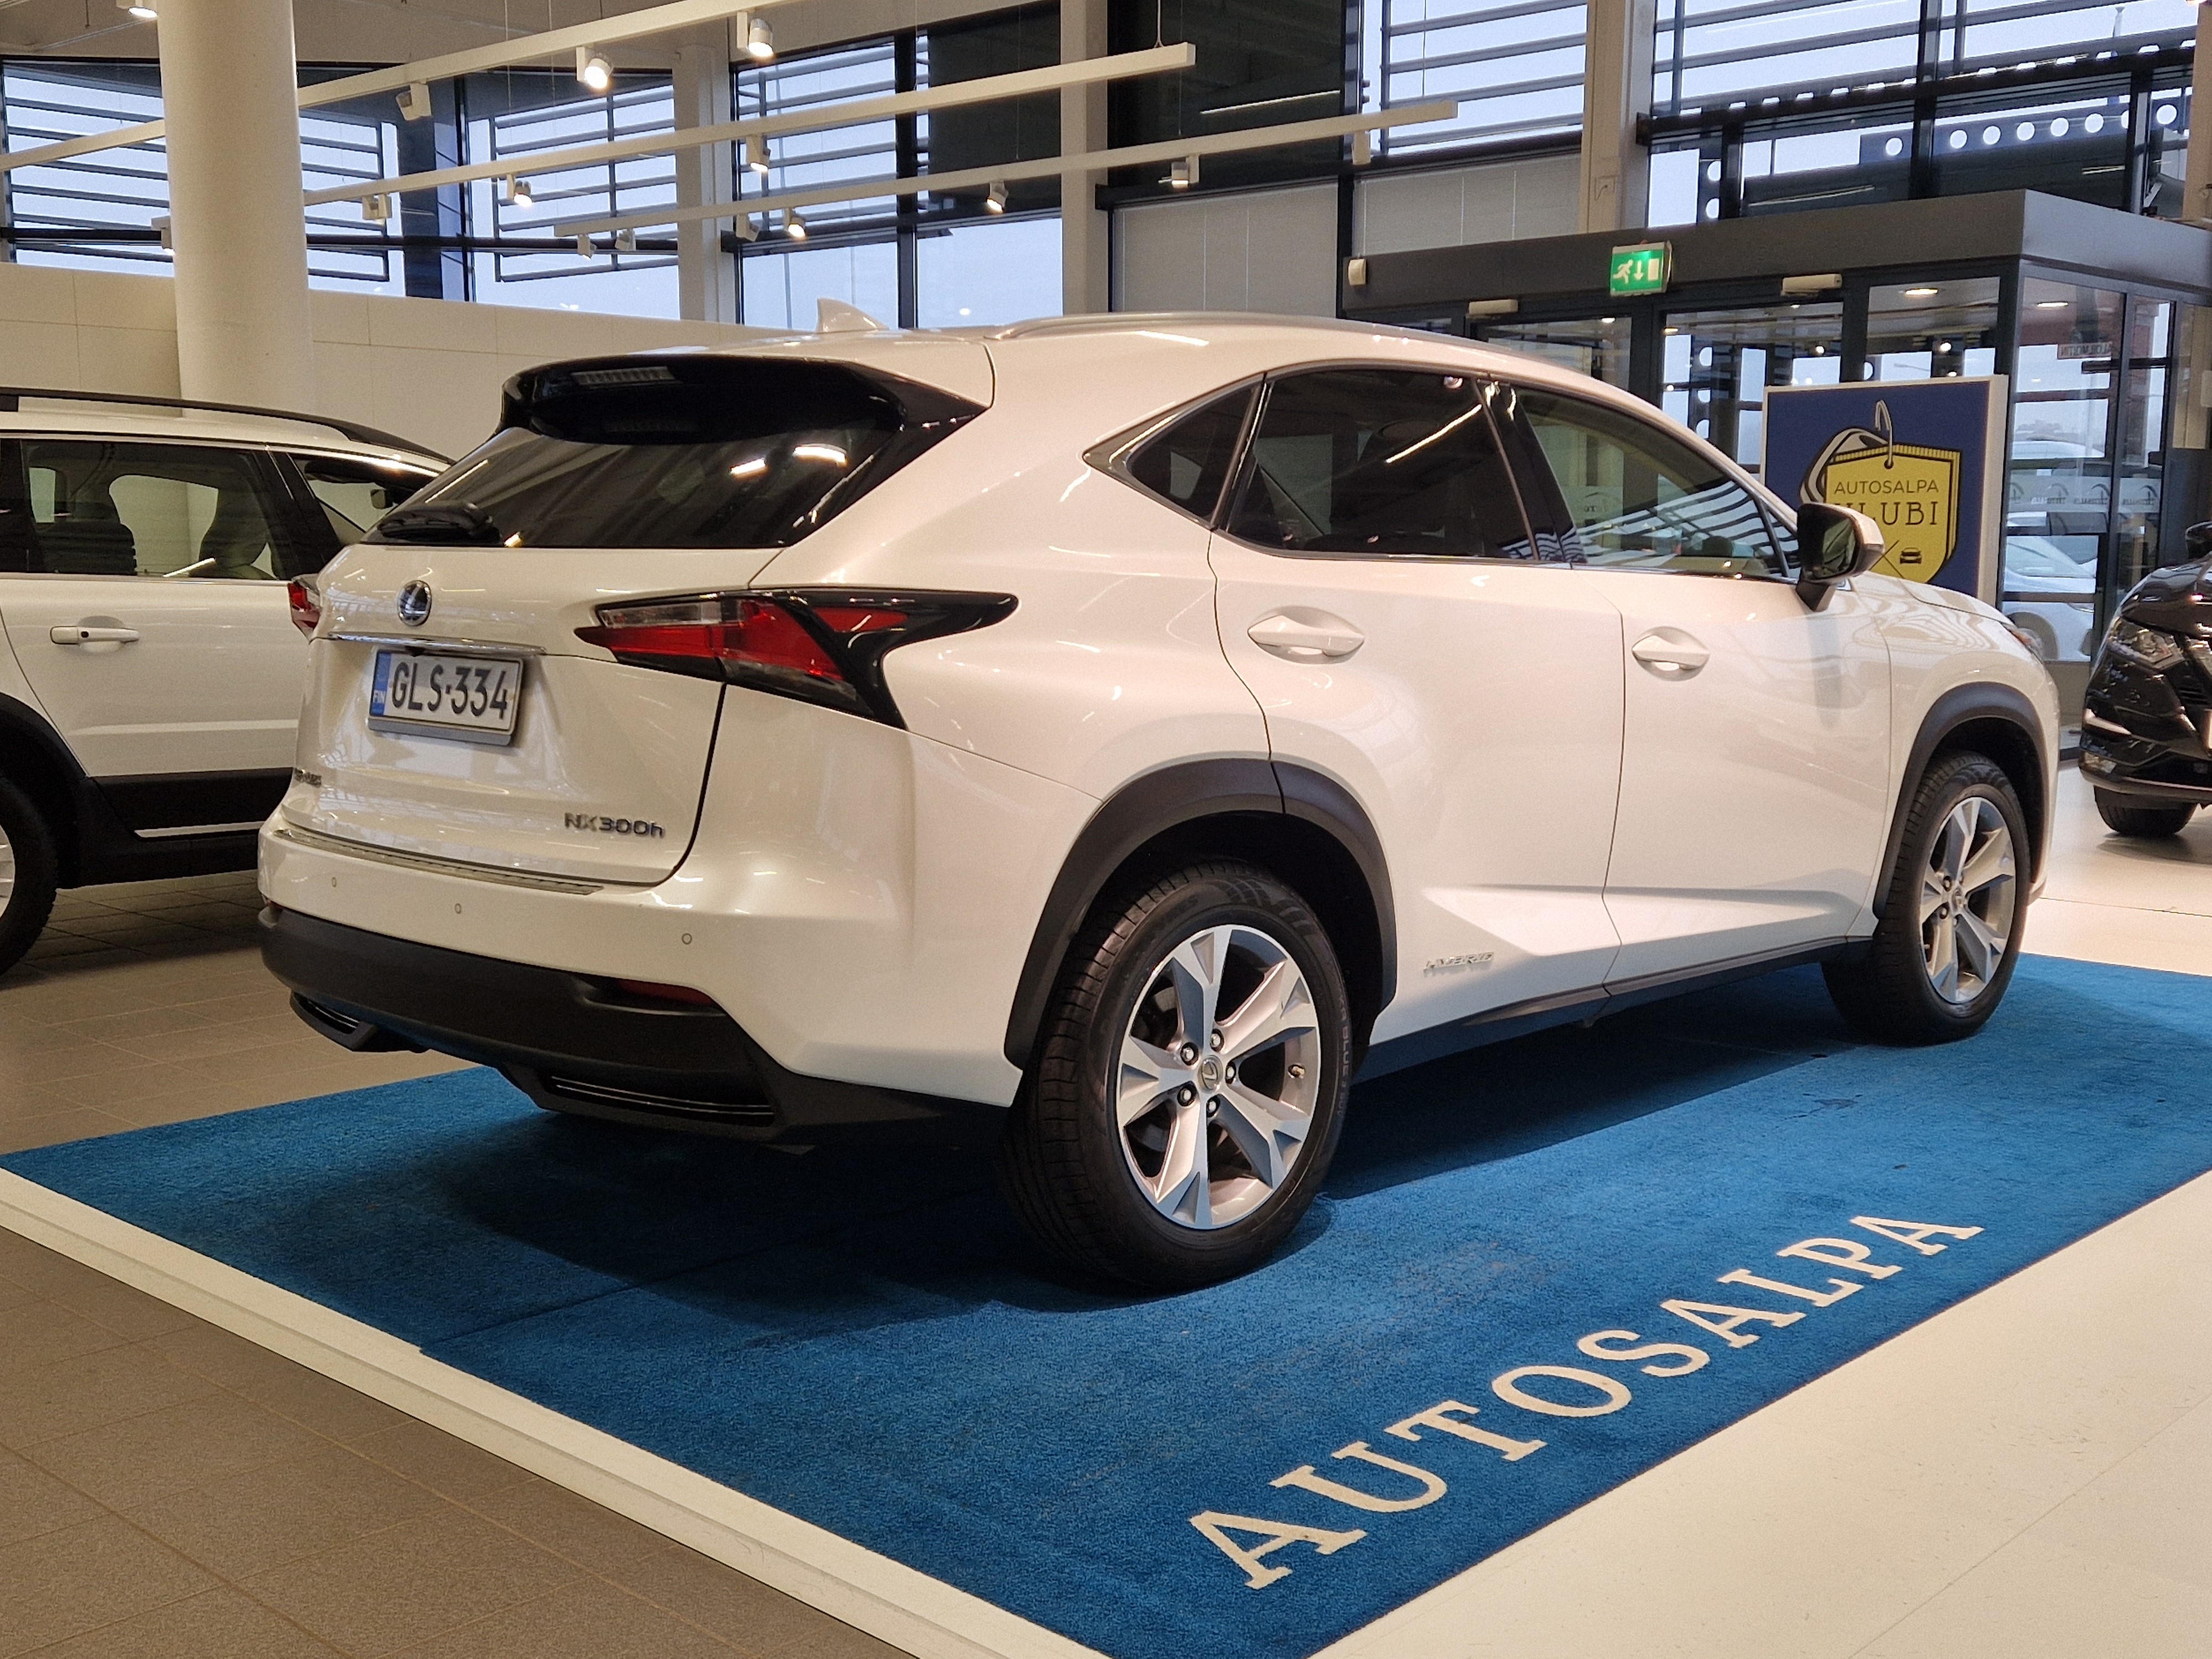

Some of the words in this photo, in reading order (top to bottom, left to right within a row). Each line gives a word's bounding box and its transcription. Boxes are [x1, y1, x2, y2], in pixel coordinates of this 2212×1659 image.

[1834, 479, 1939, 494] AUTOSALPA
[1834, 501, 1939, 525] UBI
[373, 689, 385, 703] FIN
[392, 662, 508, 719] GLS-334
[1187, 1214, 1986, 1589] AUTOSALPA
